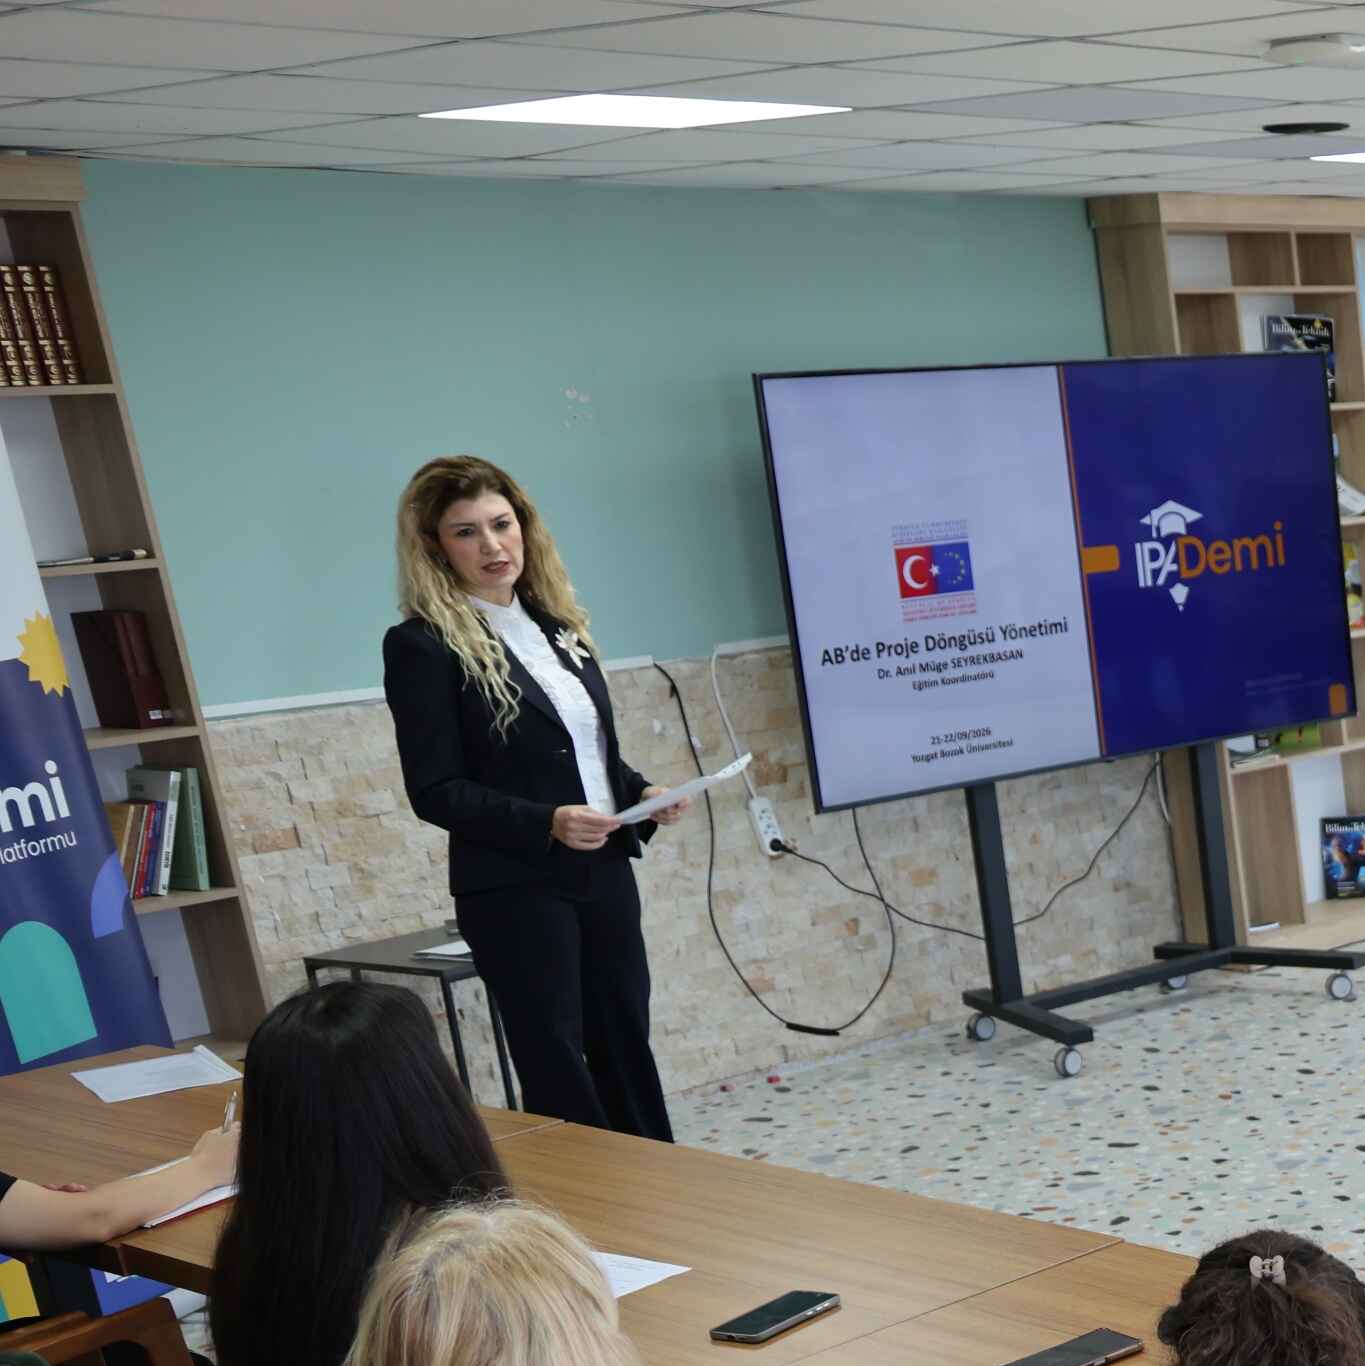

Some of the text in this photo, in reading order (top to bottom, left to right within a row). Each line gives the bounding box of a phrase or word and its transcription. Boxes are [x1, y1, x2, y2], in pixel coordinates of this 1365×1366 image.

[876, 637, 920, 660] Proje
[924, 626, 996, 652] Döngüsü
[999, 616, 1069, 643] Yönetimi
[876, 668, 893, 681] Dr.
[918, 660, 949, 675] Müge
[950, 649, 1024, 669] SEYREKBASAN
